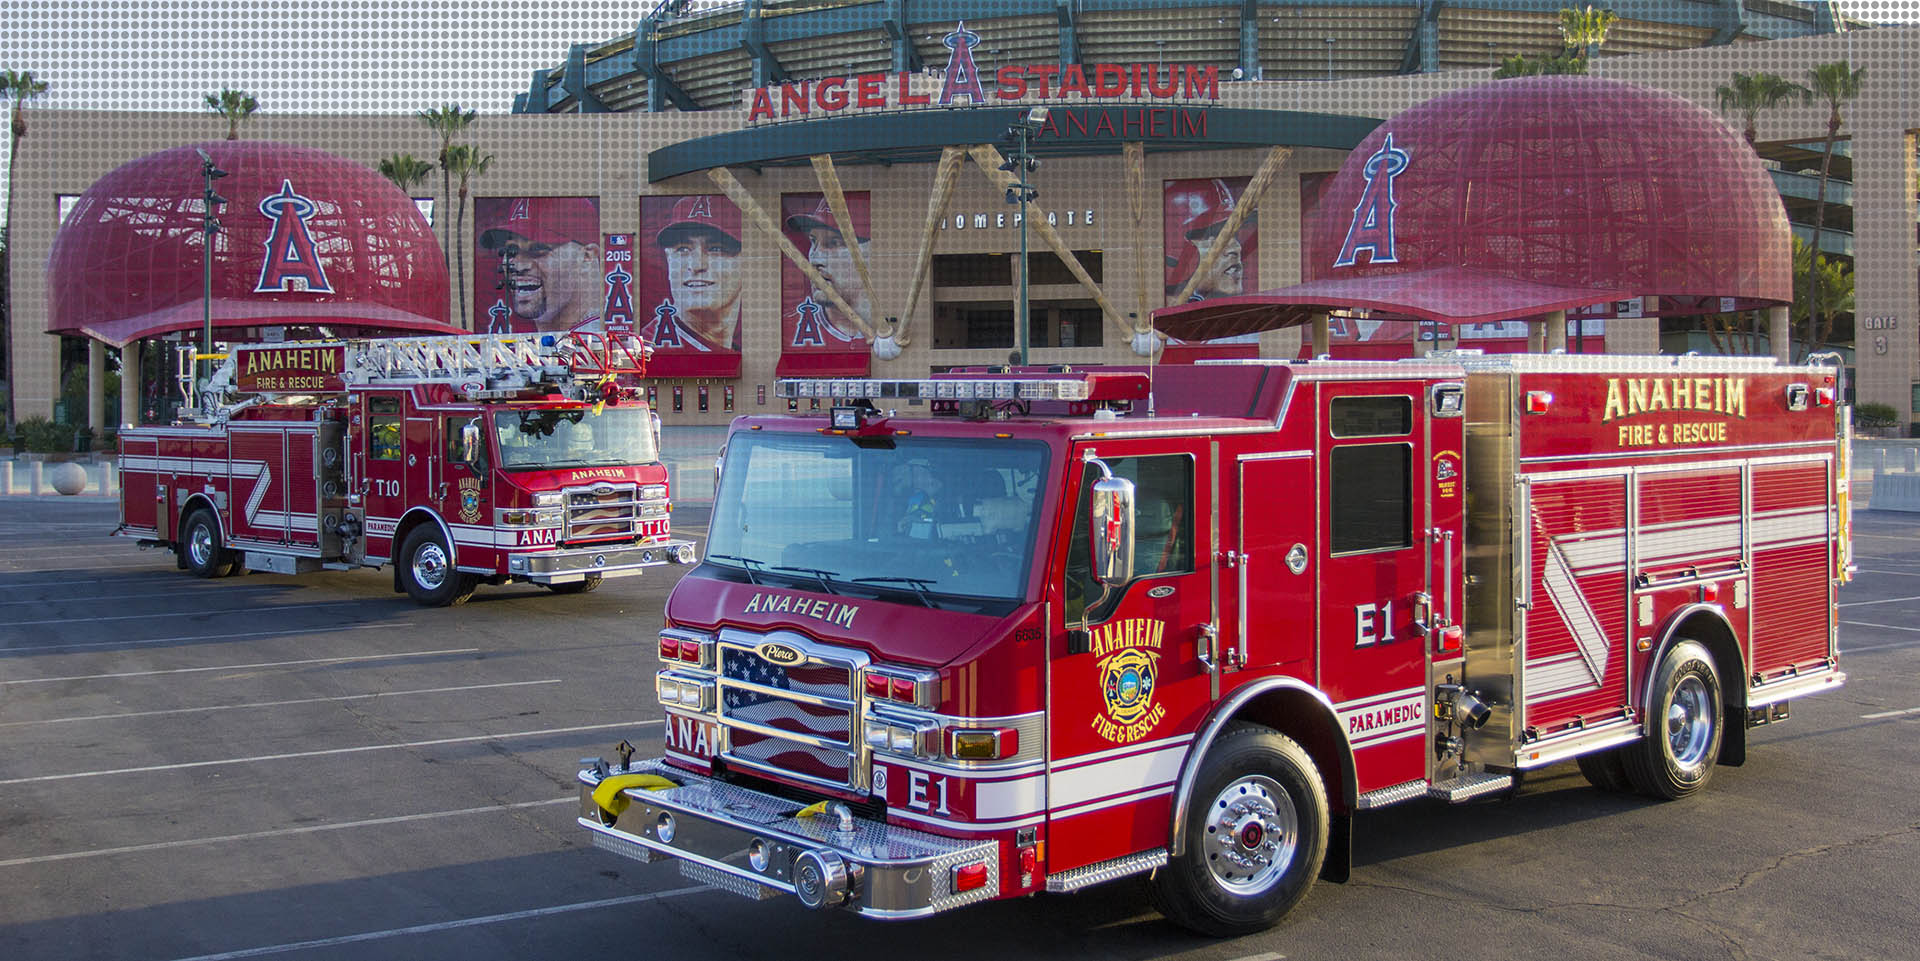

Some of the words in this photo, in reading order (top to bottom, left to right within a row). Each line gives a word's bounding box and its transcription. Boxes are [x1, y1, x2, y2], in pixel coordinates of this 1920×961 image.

[748, 70, 932, 122] ANGEL
[939, 20, 985, 105] A
[996, 63, 1220, 100] STADIUM
[1037, 109, 1208, 137] ANAHEIM
[1333, 132, 1409, 268] A
[253, 179, 336, 294] A
[606, 250, 632, 262] 2015
[604, 263, 633, 323] A
[653, 299, 684, 347] A
[792, 296, 826, 346] A
[1865, 316, 1897, 329] GATE
[1876, 336, 1888, 355] 3
[247, 349, 336, 375] ANAHEIM
[256, 377, 276, 389] FIRE
[279, 377, 286, 389] &
[288, 376, 325, 389] RESCUE
[1602, 378, 1747, 424] ANAHEIM
[1618, 424, 1653, 447] FIRE
[1657, 424, 1668, 445] &
[1673, 422, 1727, 444] RESCUE
[375, 479, 400, 497] T10
[571, 469, 626, 481] ANAHEIM
[519, 530, 555, 545] ANA
[644, 520, 670, 535] T10
[744, 593, 860, 629] ANAHEIM
[1355, 600, 1395, 648] E1
[766, 644, 794, 661] Pierce
[1092, 618, 1166, 658] ANAHEIM
[1349, 702, 1422, 734] PARAMEDIC
[906, 769, 951, 818] E1
